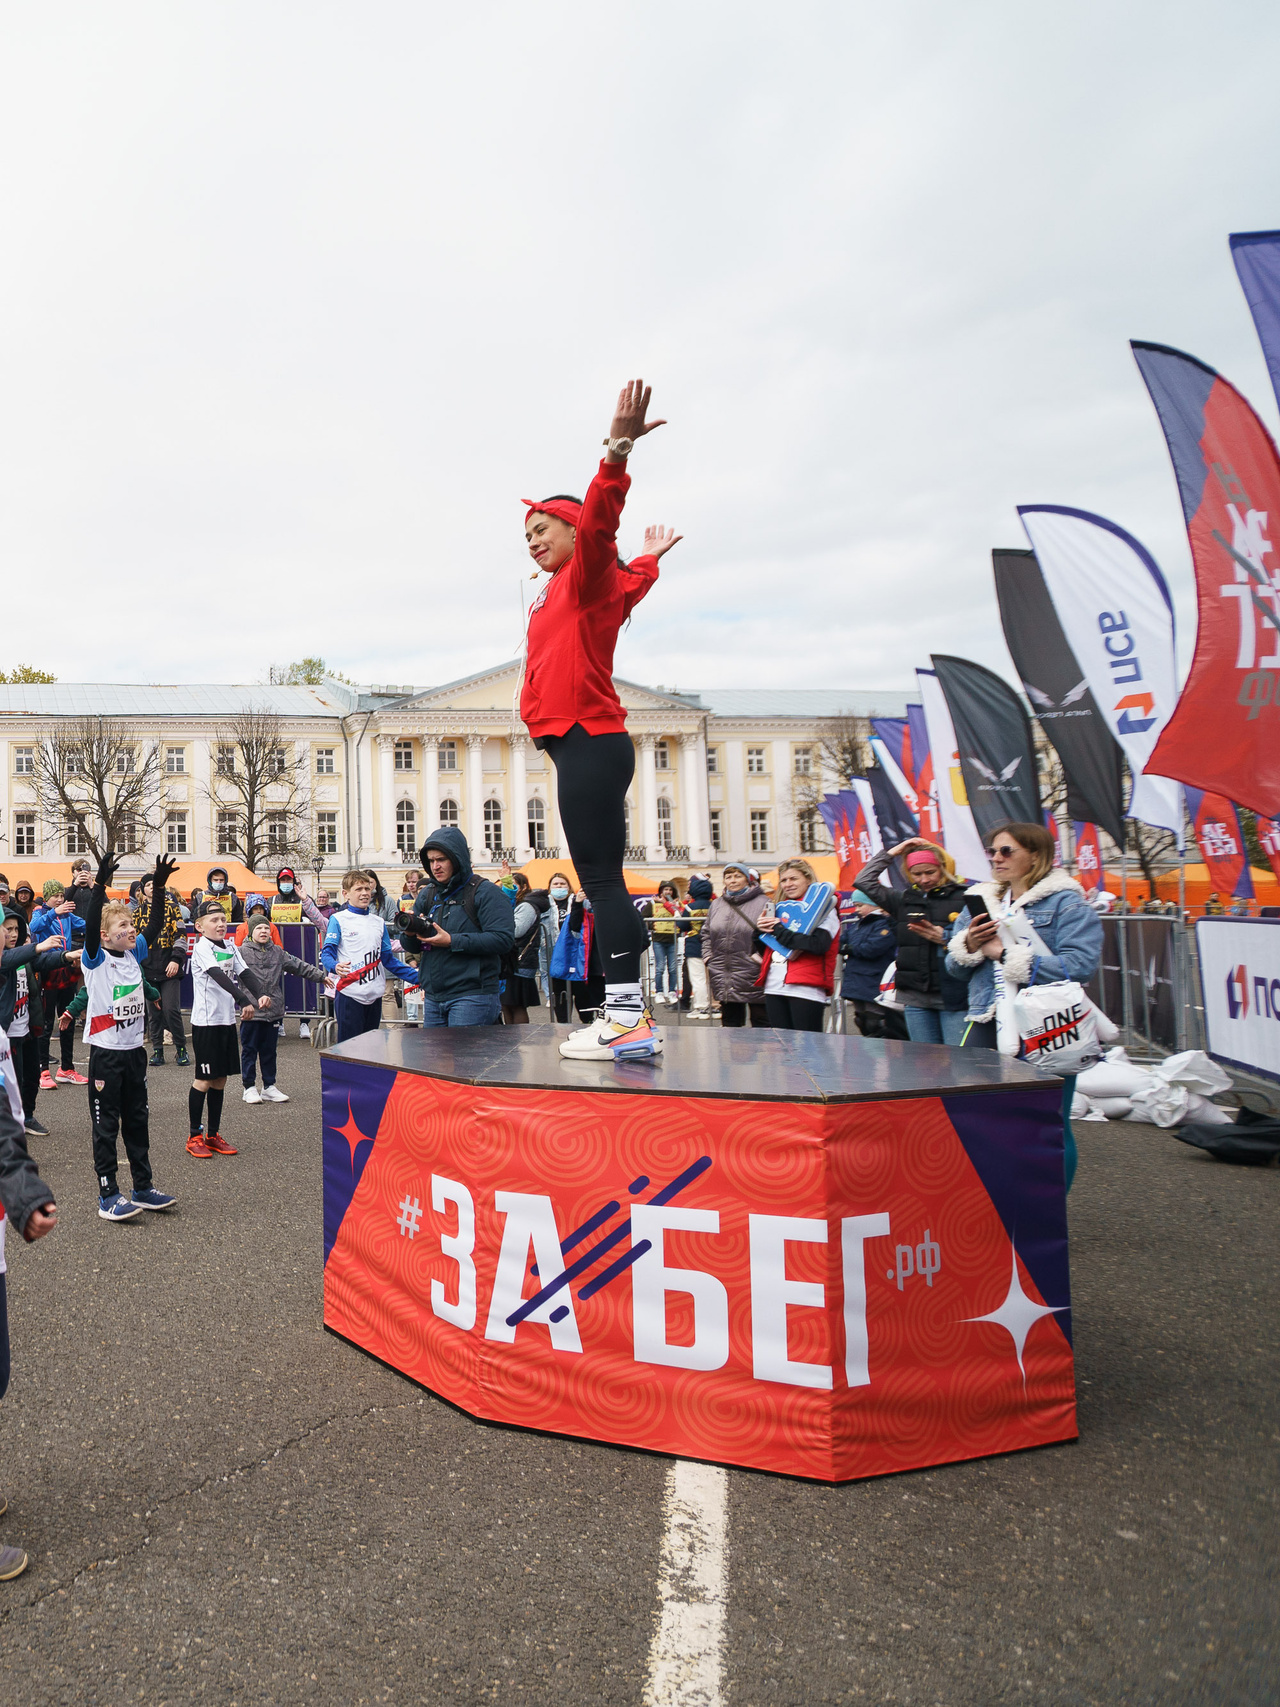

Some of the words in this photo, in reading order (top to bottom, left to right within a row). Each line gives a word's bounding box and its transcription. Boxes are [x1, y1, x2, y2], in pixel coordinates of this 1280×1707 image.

[115, 1003, 144, 1017] 15087
[1044, 1003, 1082, 1032] ONE
[1038, 1025, 1079, 1055] RUN
[200, 1063, 211, 1075] 11
